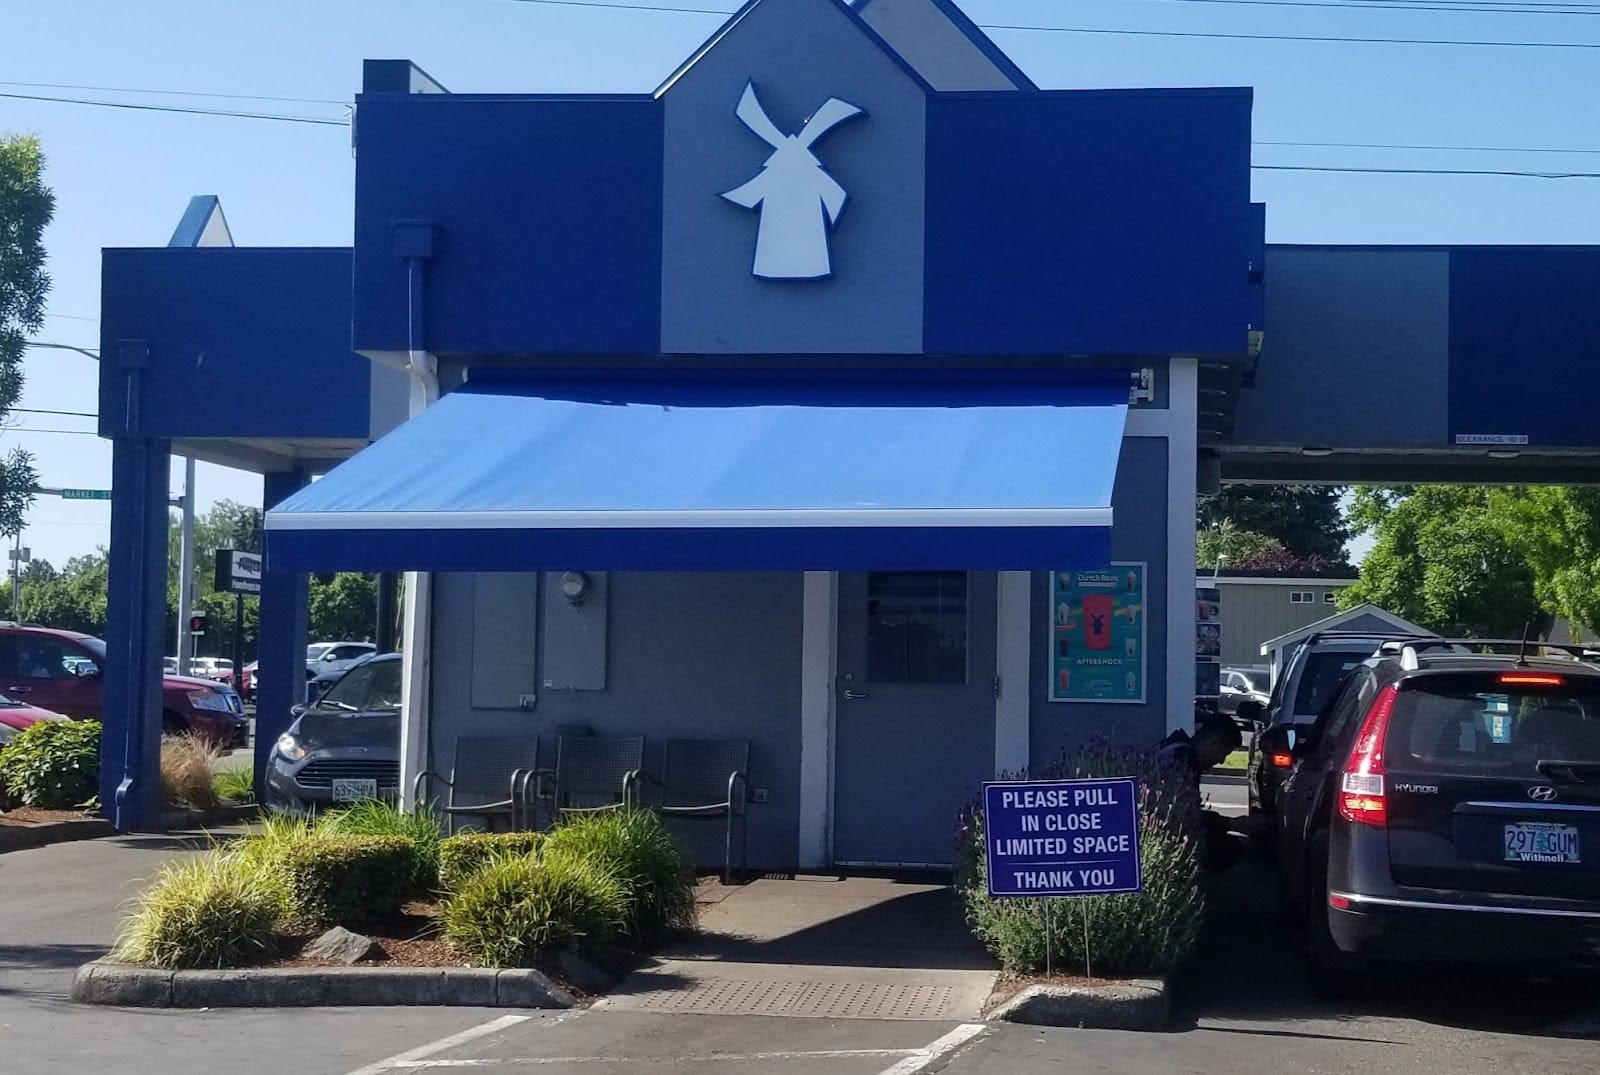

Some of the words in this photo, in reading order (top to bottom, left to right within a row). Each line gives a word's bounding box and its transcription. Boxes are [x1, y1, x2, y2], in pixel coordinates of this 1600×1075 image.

[1076, 657, 1122, 666] AFTERSHOCK
[1395, 783, 1439, 794] HYUNDAI
[1002, 790, 1069, 809] PLEASE
[1074, 788, 1118, 807] PULL
[1021, 815, 1039, 832] IN
[1045, 813, 1102, 831] CLOSE
[996, 838, 1067, 856] LIMITED
[1073, 835, 1130, 854] SPACE
[1506, 830, 1536, 852] 297
[1547, 832, 1578, 854] GUM
[1520, 852, 1564, 863] Withnell
[1013, 870, 1075, 889] THANK
[1079, 869, 1116, 887] YOU
